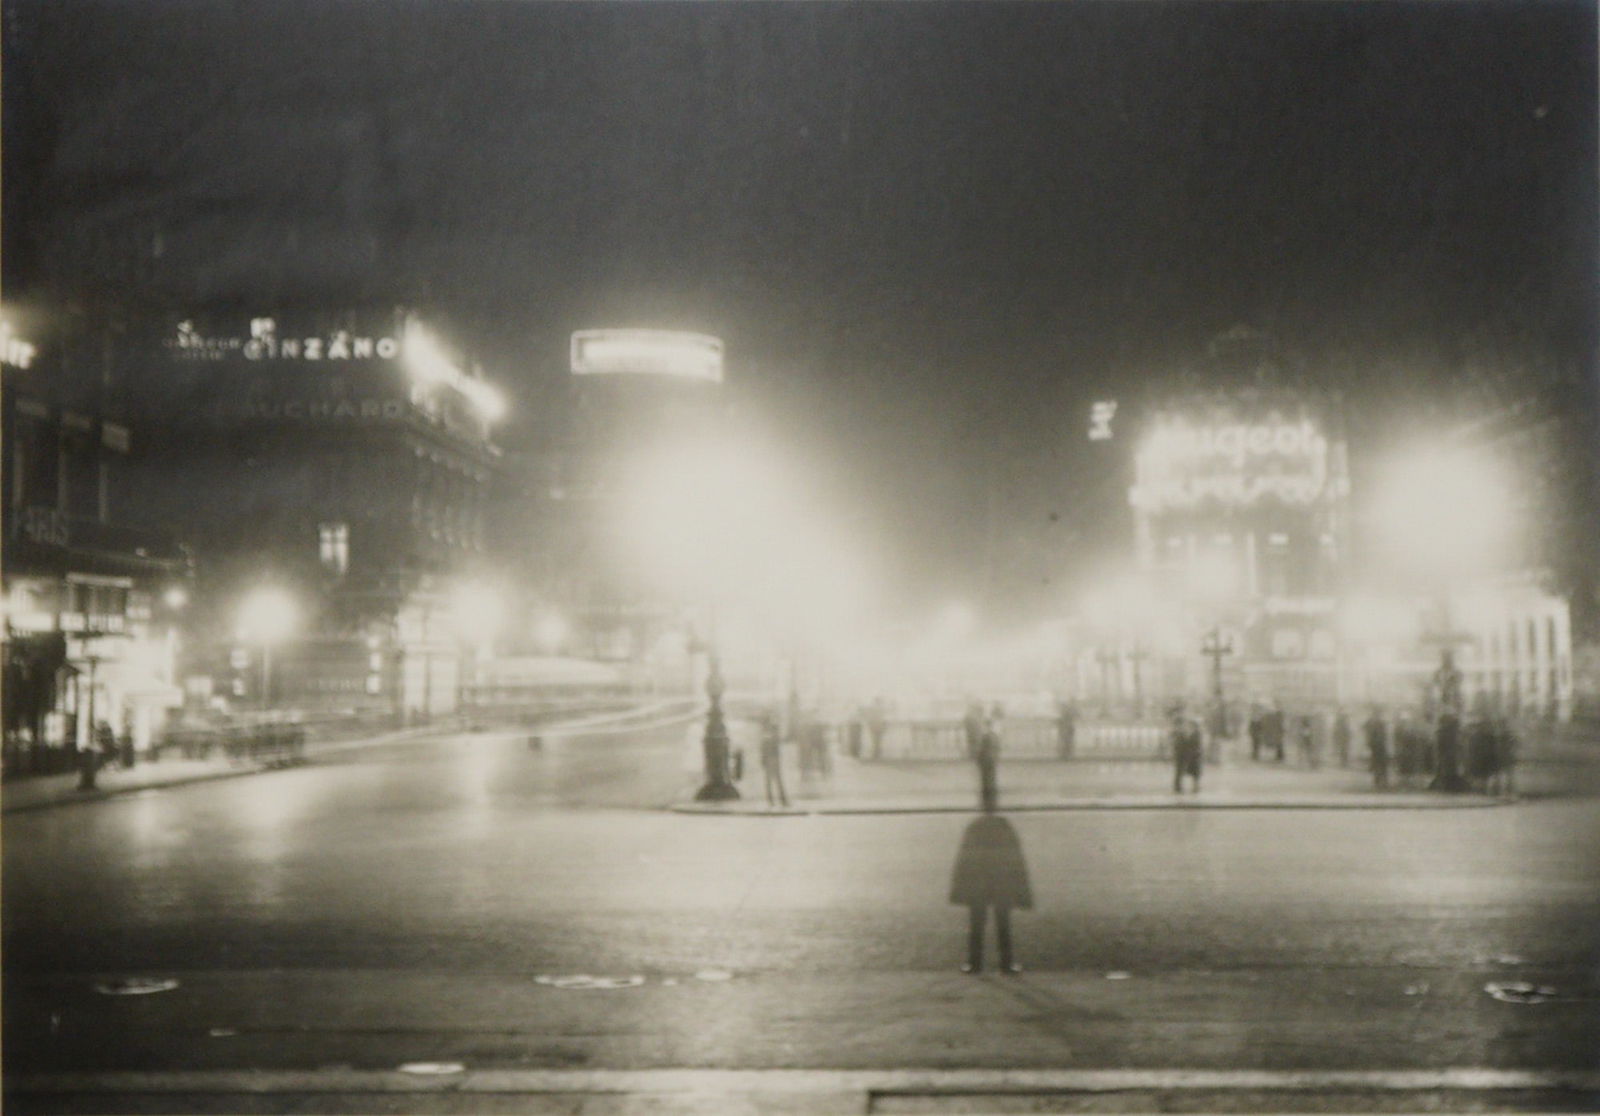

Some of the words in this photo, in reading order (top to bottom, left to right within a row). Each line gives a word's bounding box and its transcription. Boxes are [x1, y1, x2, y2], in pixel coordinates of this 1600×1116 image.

[243, 336, 397, 362] CINZANO
[241, 399, 404, 419] UCHARD
[1146, 420, 1316, 467] ugeot
